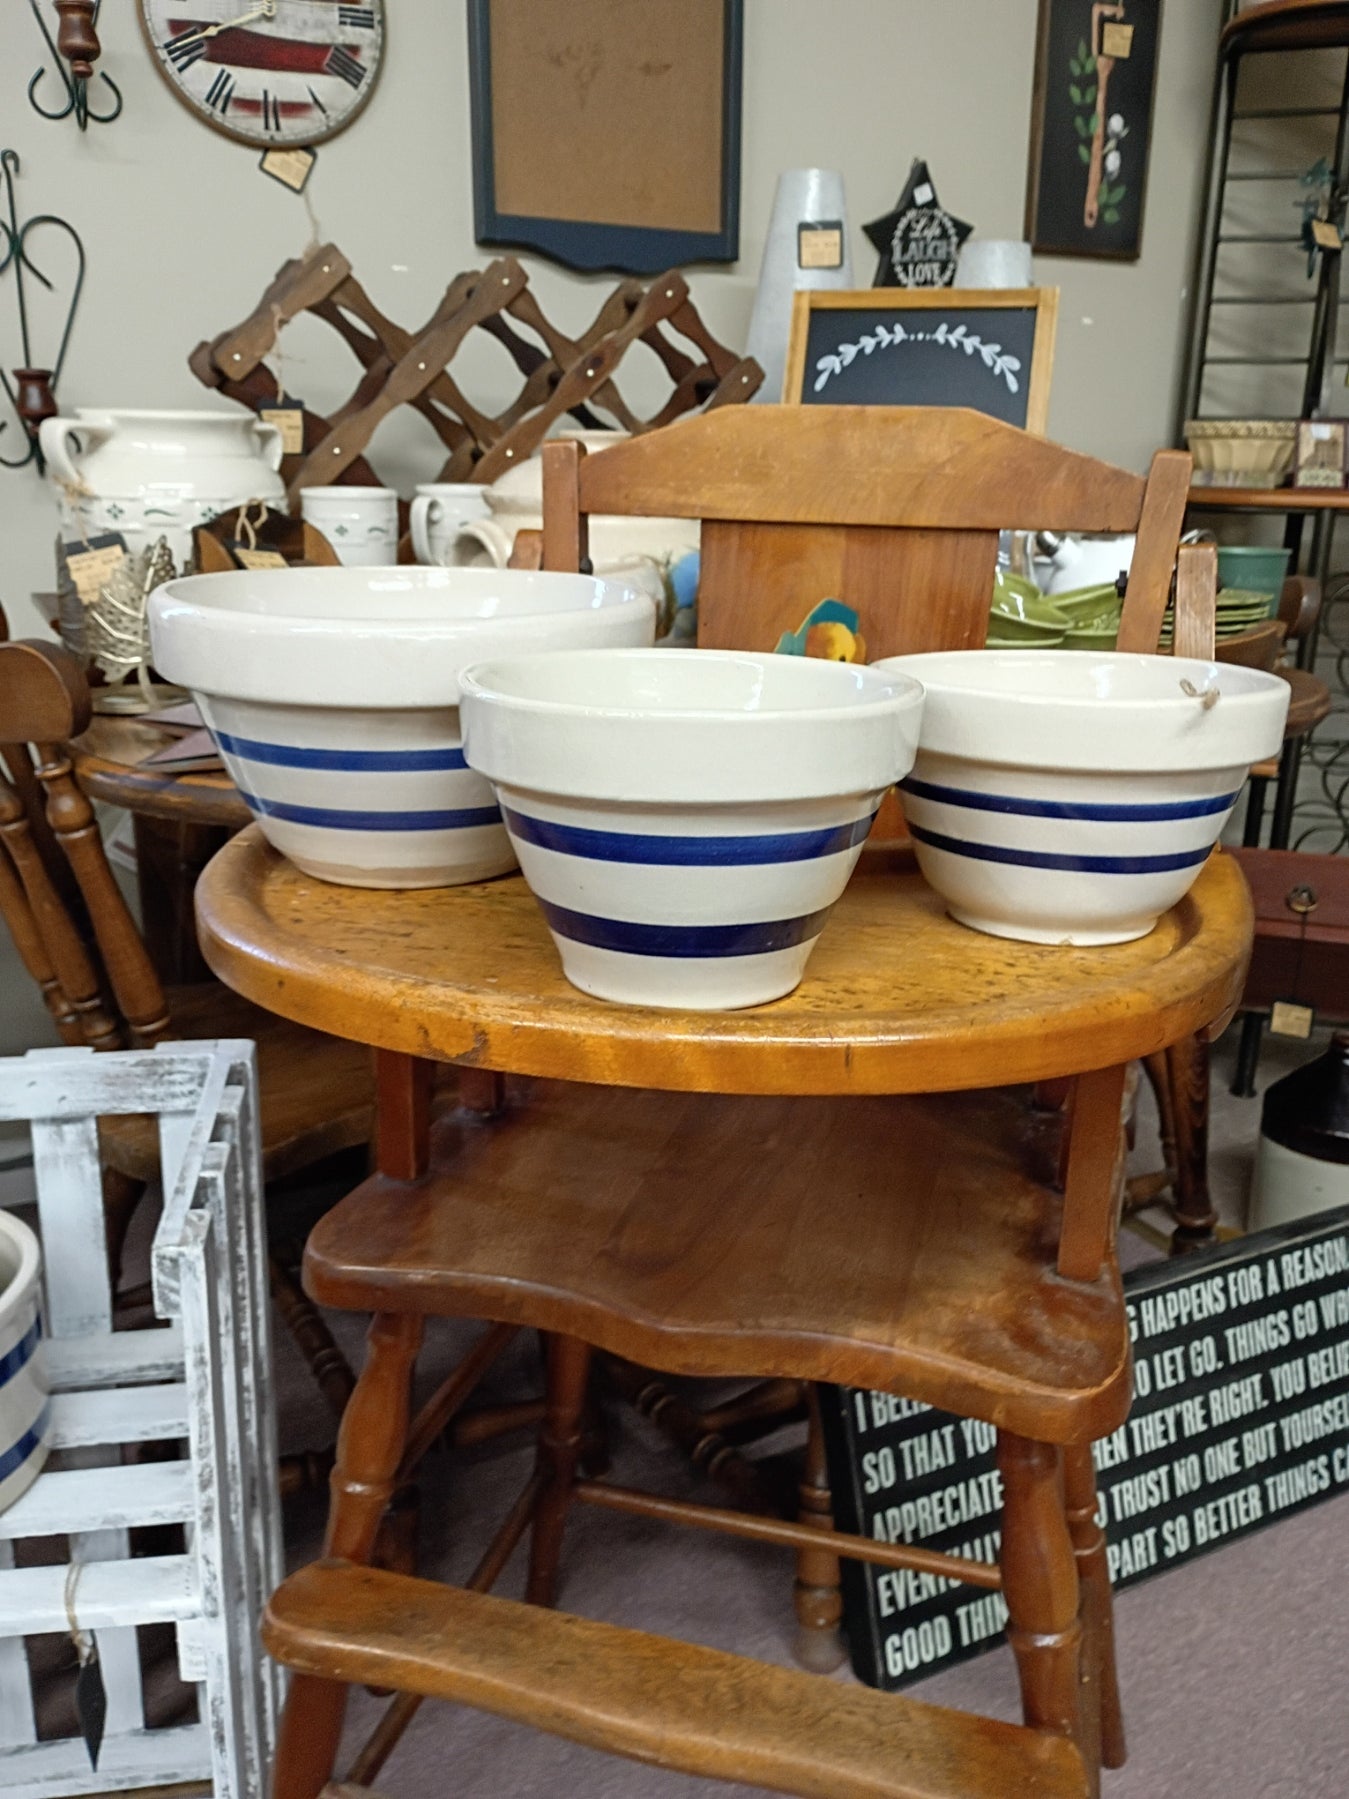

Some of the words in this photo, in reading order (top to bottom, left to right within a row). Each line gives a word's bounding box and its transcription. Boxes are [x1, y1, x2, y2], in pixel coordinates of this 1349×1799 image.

[854, 1391, 867, 1433] I
[1140, 1276, 1227, 1338] HAPPENS
[1227, 1264, 1264, 1309] FOR
[1266, 1258, 1281, 1297] A
[862, 1446, 896, 1494] SO
[899, 1424, 956, 1481] THAT
[1153, 1345, 1186, 1391] LET
[1189, 1335, 1224, 1378] GO.
[1224, 1309, 1291, 1365] THINGS
[1291, 1300, 1318, 1339] GO
[873, 1469, 1005, 1544] APPRECIATE
[1130, 1395, 1208, 1457] THEY'RE
[1208, 1373, 1269, 1428] RIGHT.
[1269, 1358, 1307, 1403] YOU
[1307, 1338, 1349, 1389] BELIE
[1110, 1464, 1171, 1522] TRUST
[1173, 1453, 1202, 1497] NO
[1204, 1437, 1242, 1484] ONE
[1242, 1421, 1277, 1469] BUT
[1279, 1392, 1349, 1452] YOURSEL
[884, 1614, 952, 1677] GOOD
[956, 1592, 1010, 1647] THIN
[1106, 1527, 1158, 1584] PART
[1161, 1514, 1191, 1559] SO
[1193, 1484, 1263, 1546] BETTER
[1265, 1454, 1330, 1513] THINGS
